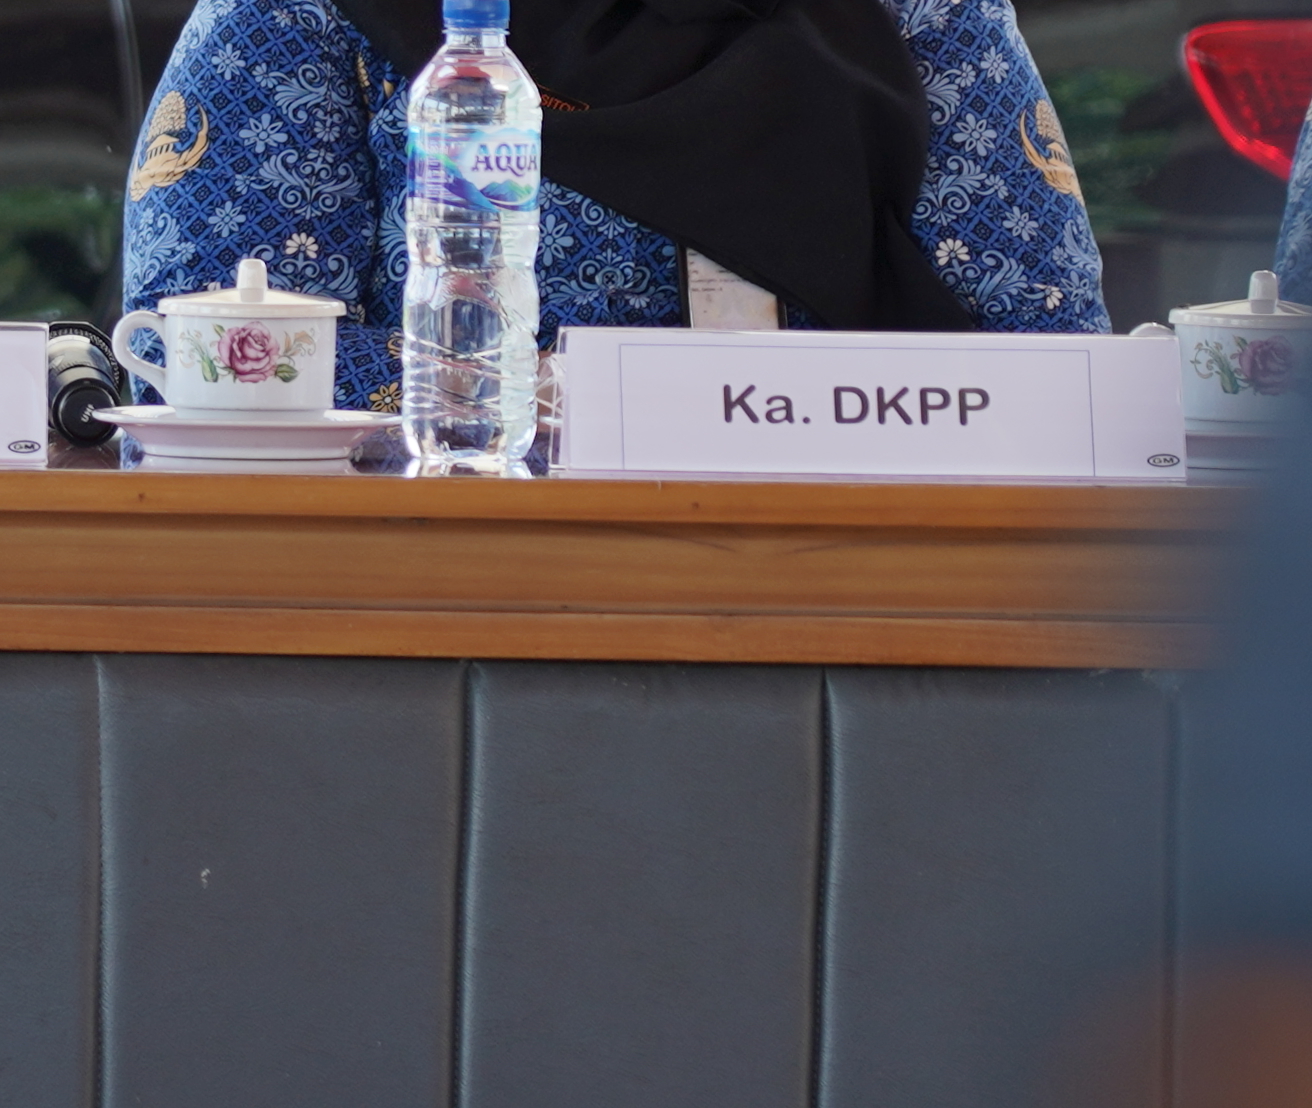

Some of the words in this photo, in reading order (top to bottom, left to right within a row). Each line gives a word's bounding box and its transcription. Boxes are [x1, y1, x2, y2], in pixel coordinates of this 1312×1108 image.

[471, 143, 538, 177] AQUA
[723, 384, 811, 424] Ka.
[833, 386, 990, 426] DKPP
